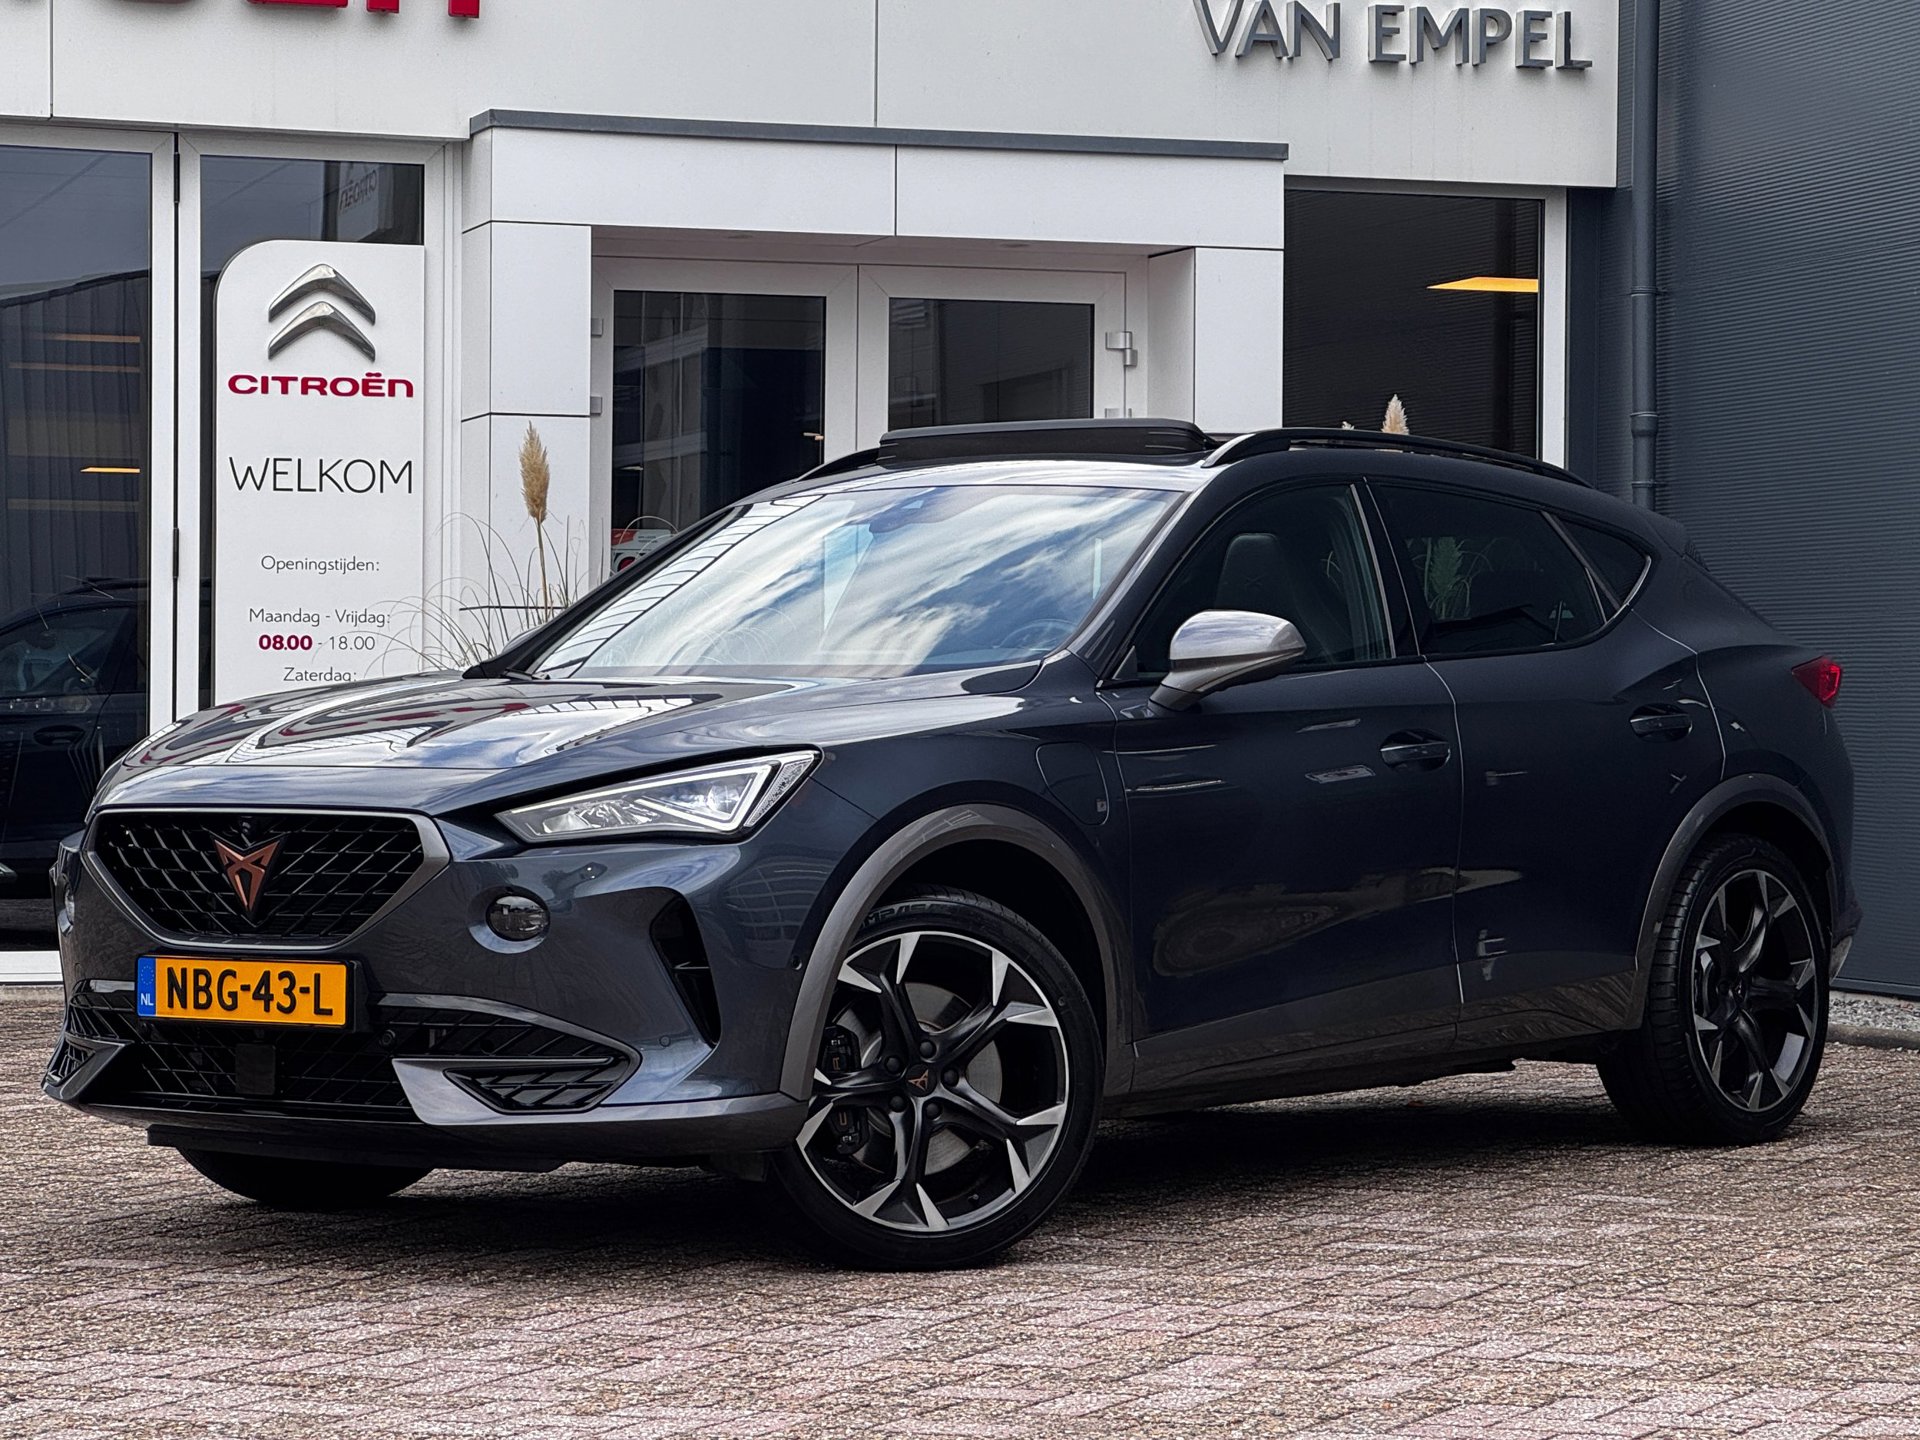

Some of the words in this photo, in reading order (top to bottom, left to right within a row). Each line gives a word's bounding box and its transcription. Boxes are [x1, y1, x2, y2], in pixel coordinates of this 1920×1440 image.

[1193, 0, 1341, 60] VAN
[1367, 3, 1594, 70] EMPEL
[229, 456, 412, 493] WELKOM
[260, 555, 380, 575] Openingstijden:
[249, 608, 320, 627] Maandag
[335, 608, 391, 628] Vrijdag:
[258, 634, 313, 651] 08.00
[329, 635, 376, 651] 18.00
[140, 992, 154, 1006] NL
[166, 966, 334, 1017] NBG-43-L
